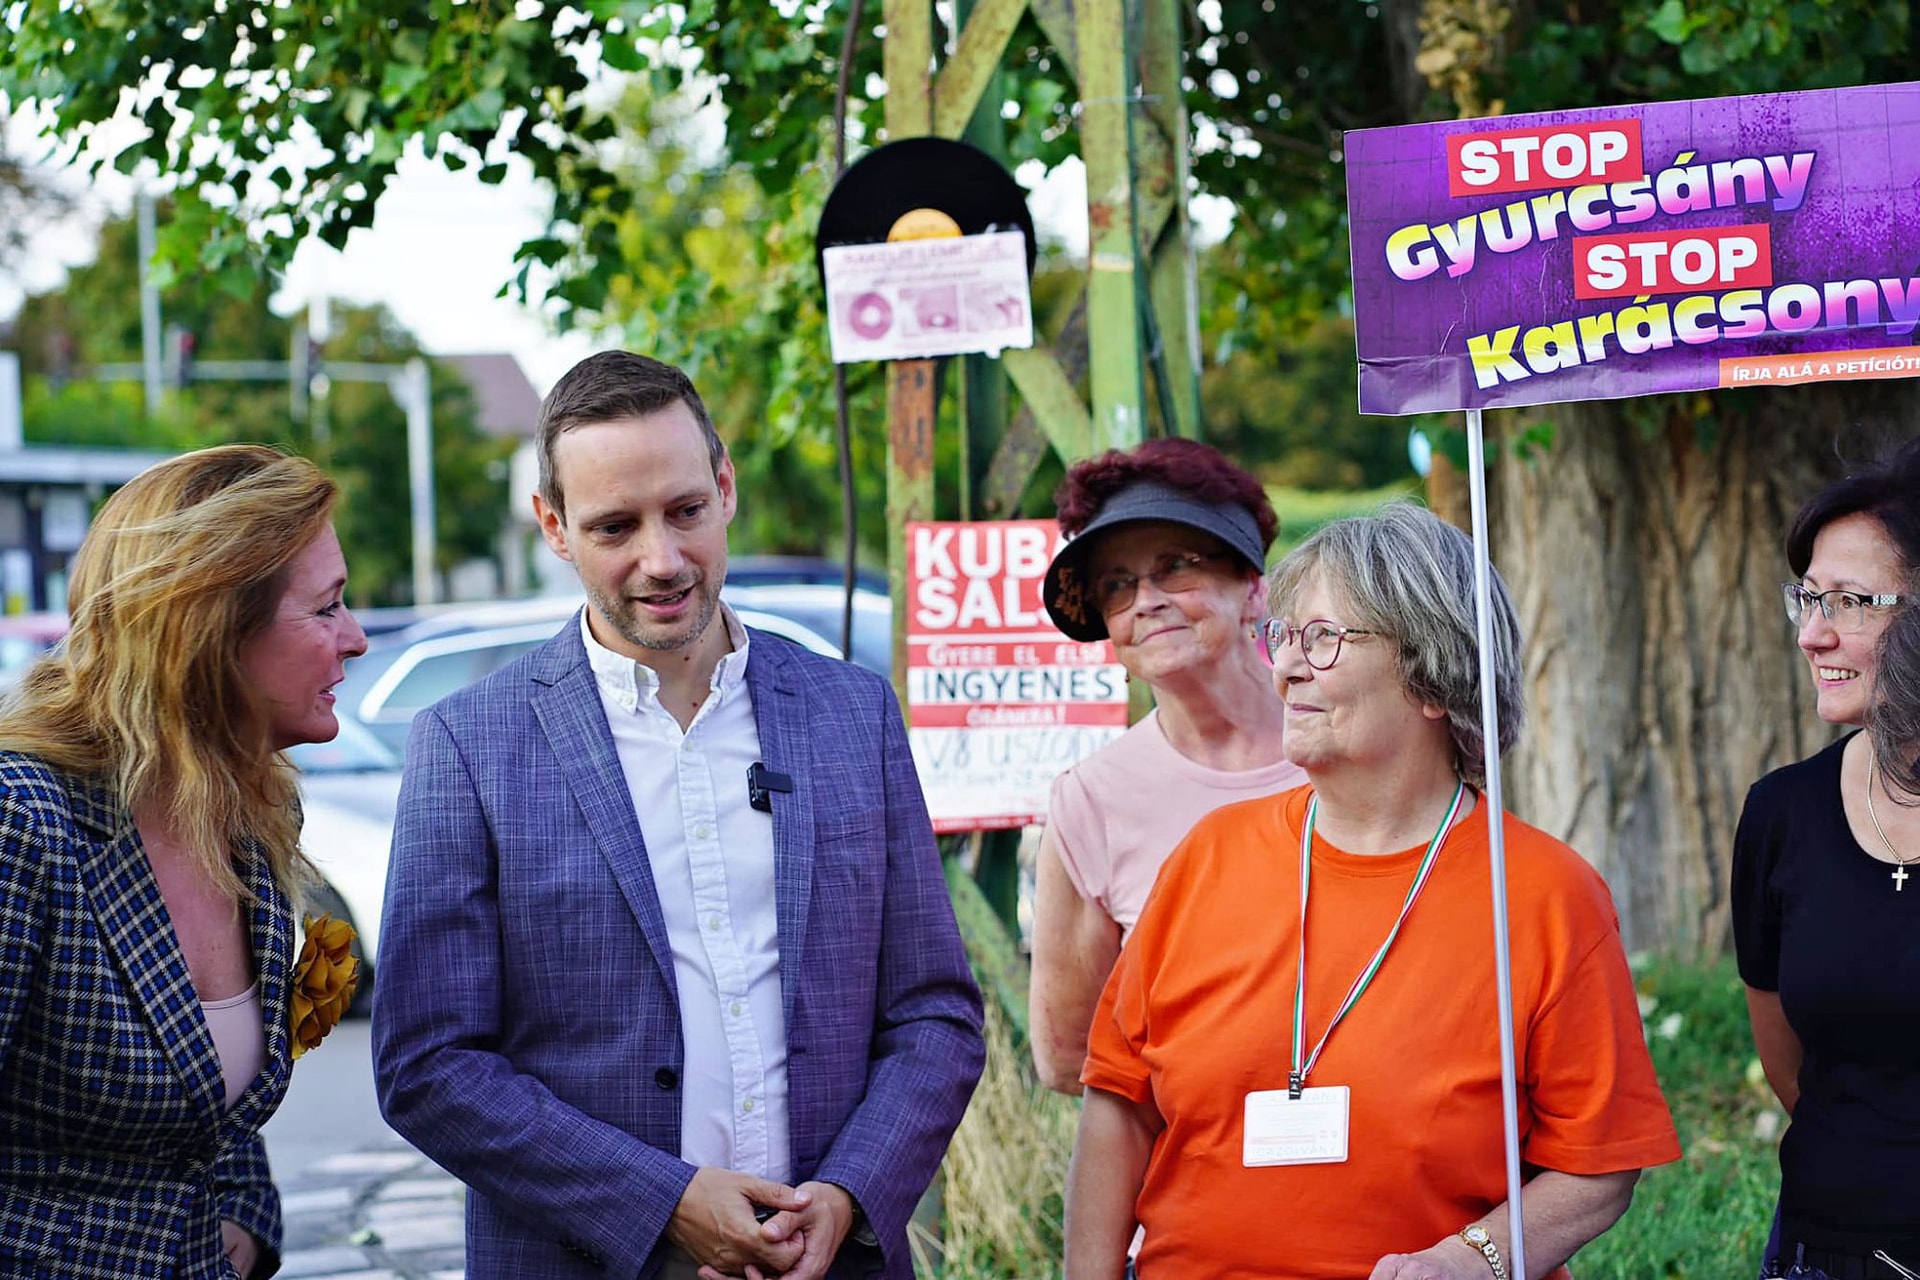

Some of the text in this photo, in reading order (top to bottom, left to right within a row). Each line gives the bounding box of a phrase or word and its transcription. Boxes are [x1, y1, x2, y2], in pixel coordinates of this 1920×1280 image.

[1460, 131, 1628, 186] STOP
[1385, 152, 1816, 281] Gyurcsány
[1587, 237, 1757, 290] STOP
[1467, 277, 1920, 389] Karácsony
[1732, 356, 1920, 381] ÍRJA ALÁ A PETÍCIÓT!
[923, 669, 1113, 700] INGYENES
